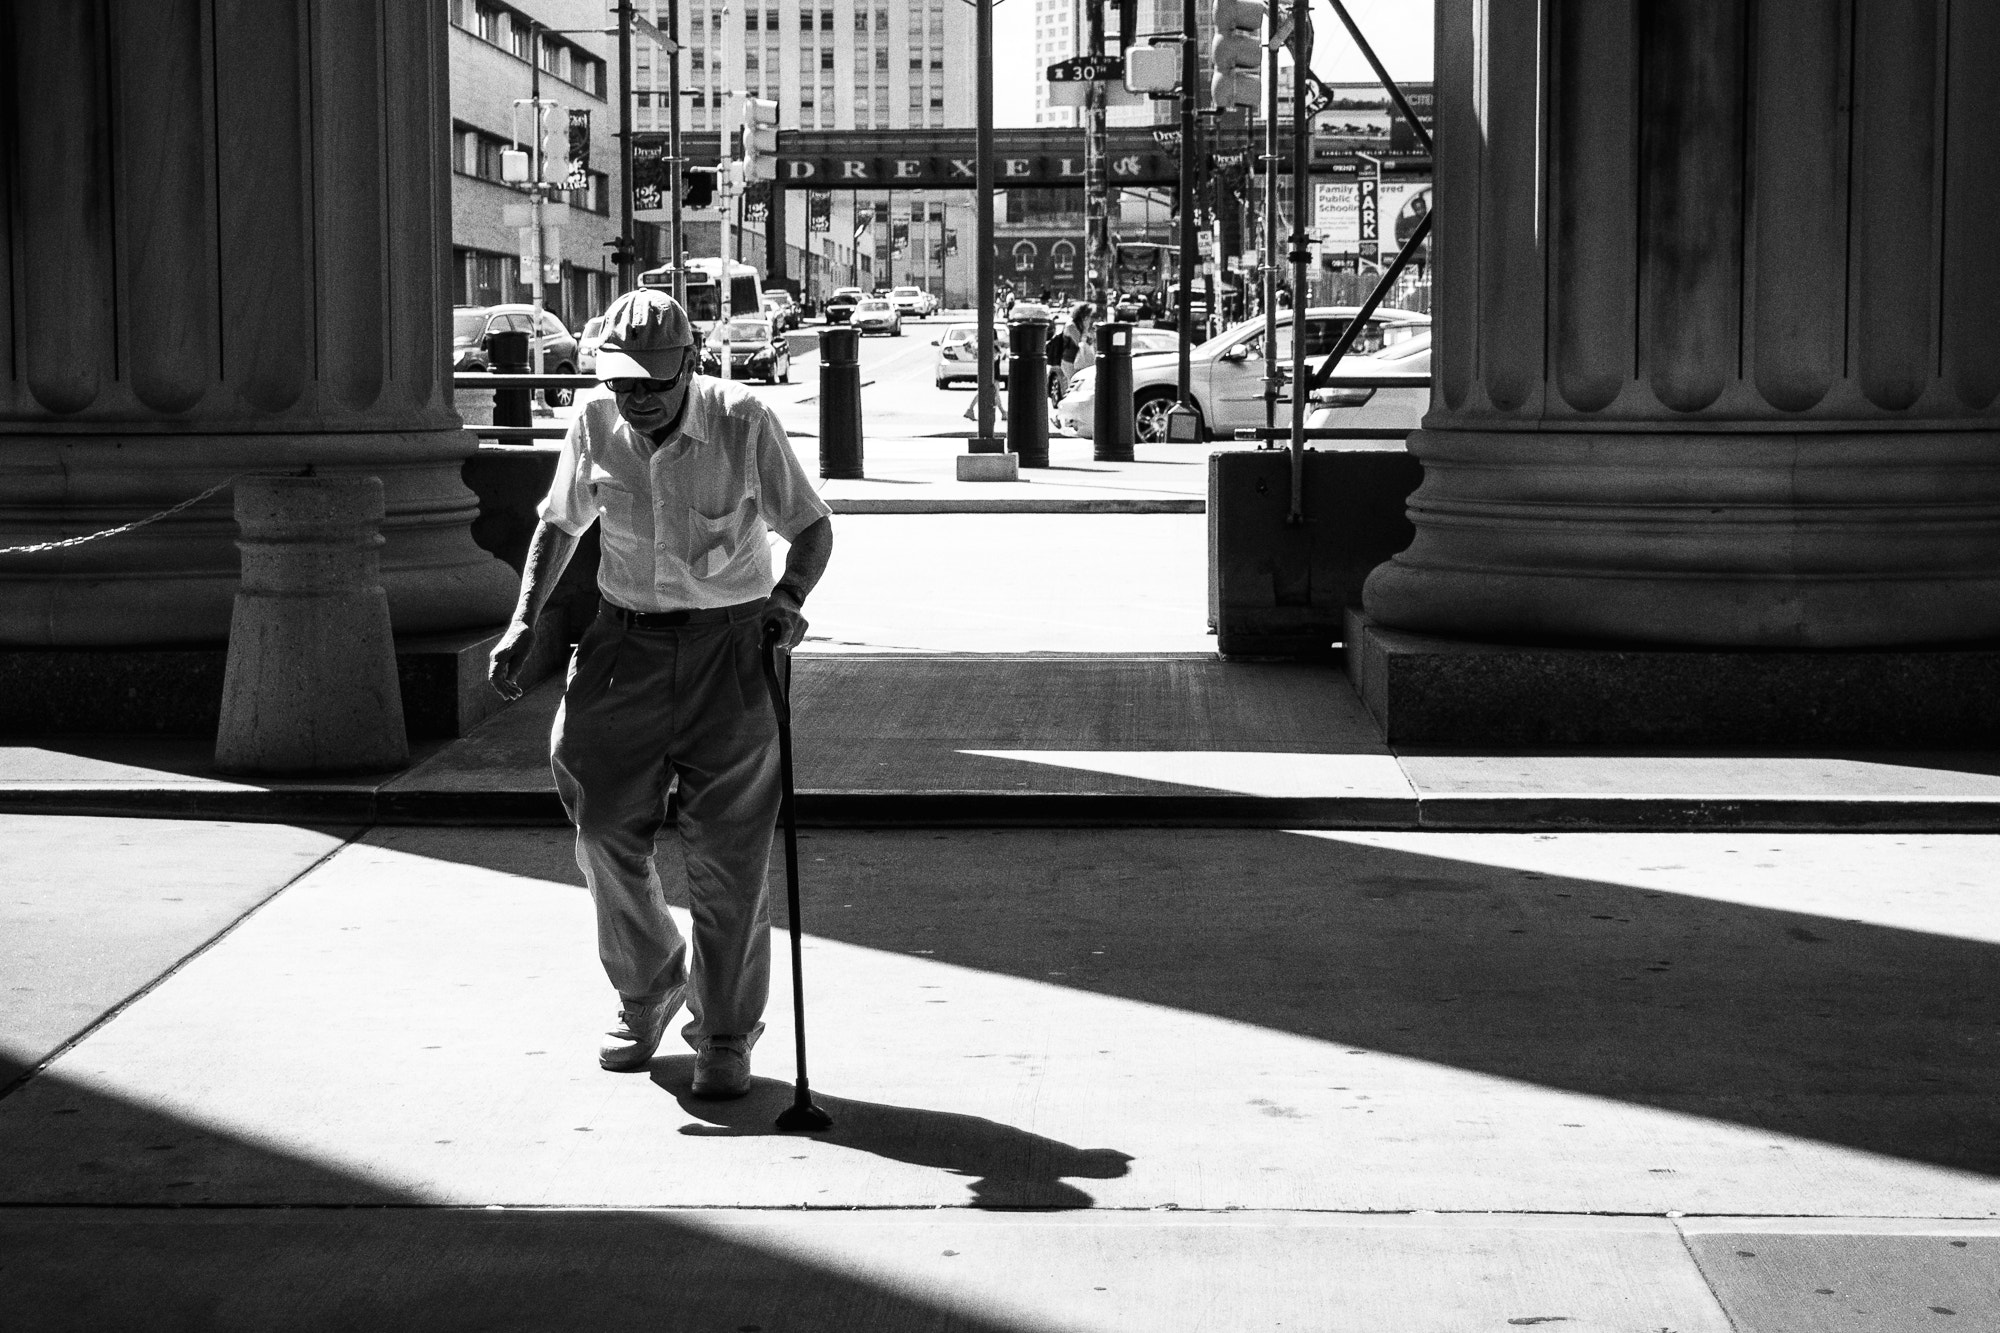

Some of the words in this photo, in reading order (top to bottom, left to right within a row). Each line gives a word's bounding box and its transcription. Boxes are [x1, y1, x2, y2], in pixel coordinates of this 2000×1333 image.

[1072, 65, 1107, 80] 30TH
[787, 159, 1087, 179] DREXEL
[1319, 184, 1353, 195] Family
[1319, 194, 1350, 204] Public
[1361, 181, 1377, 239] PARK
